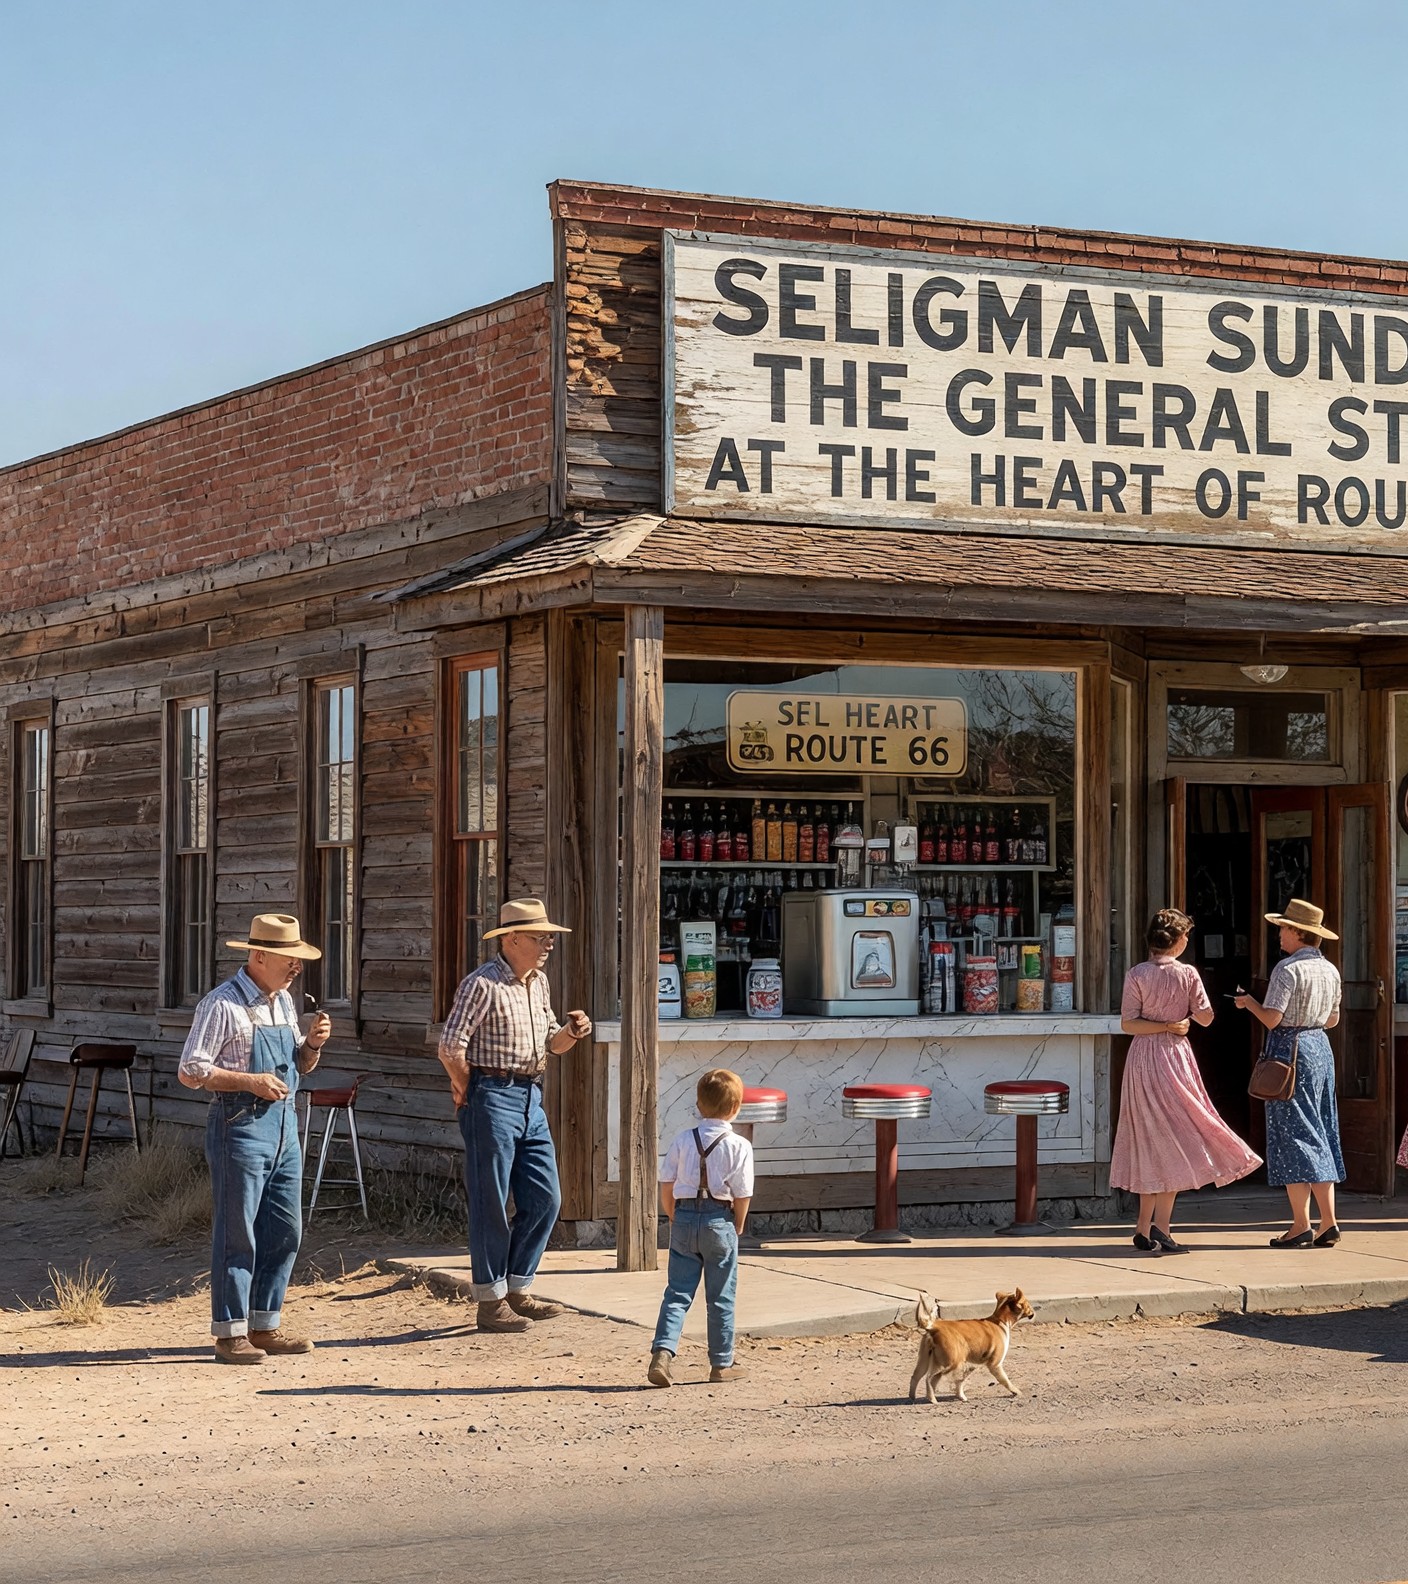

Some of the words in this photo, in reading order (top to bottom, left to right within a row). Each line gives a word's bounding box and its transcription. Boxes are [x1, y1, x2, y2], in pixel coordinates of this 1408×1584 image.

[711, 257, 1164, 369] SELIGMAN
[752, 352, 909, 431] THE
[945, 368, 1292, 457] GENERAL
[704, 437, 786, 495] AT
[818, 443, 937, 505] THE
[970, 453, 1165, 517] HEART
[1192, 467, 1265, 522] OF
[777, 700, 830, 728] SEL
[845, 702, 937, 731] HEART
[785, 733, 888, 765] ROUTE
[908, 736, 950, 767] 66
